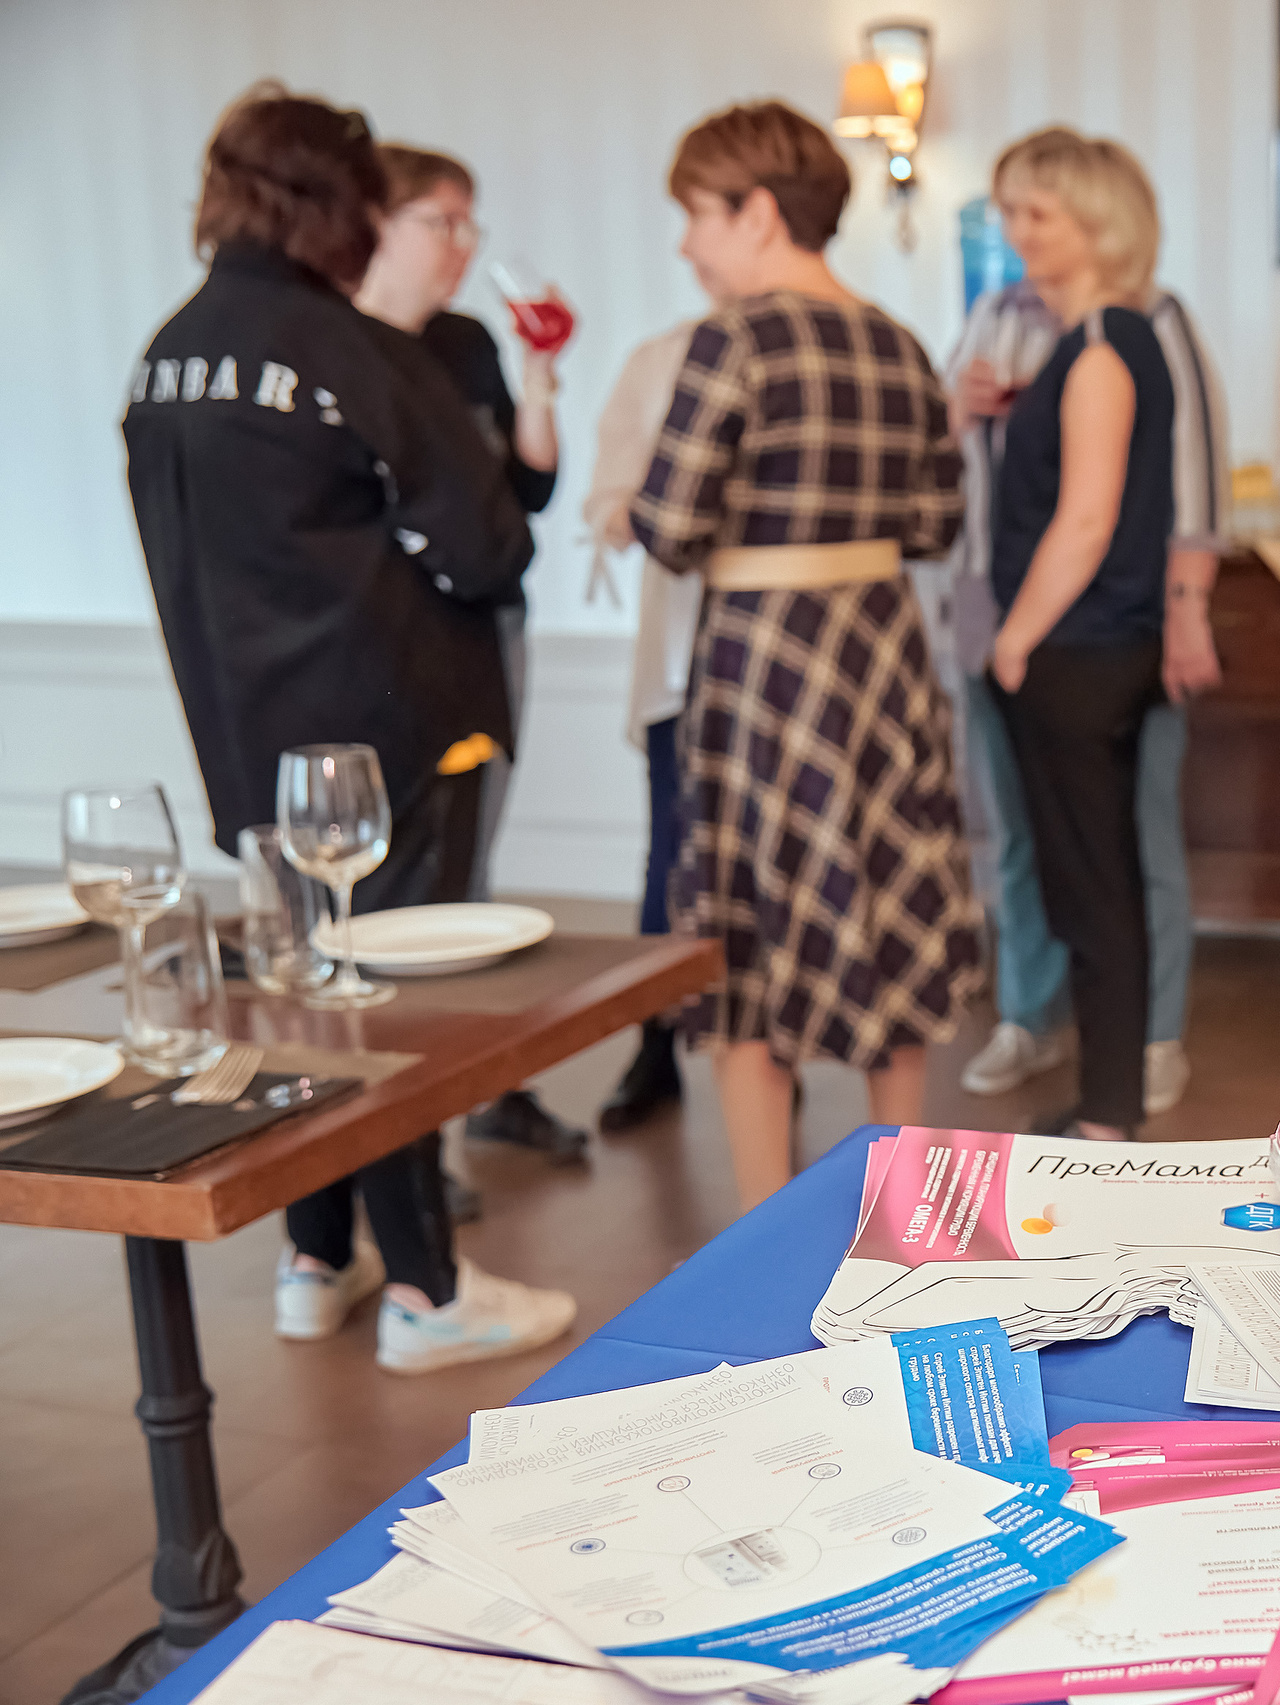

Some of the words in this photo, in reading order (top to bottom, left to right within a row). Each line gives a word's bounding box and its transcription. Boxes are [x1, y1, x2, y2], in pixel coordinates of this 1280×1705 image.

[1027, 1155, 1246, 1179] ПреМама
[902, 1204, 932, 1242] ОМЕГА-3
[1245, 1204, 1274, 1229] ДГК
[547, 1446, 570, 1456] ПО
